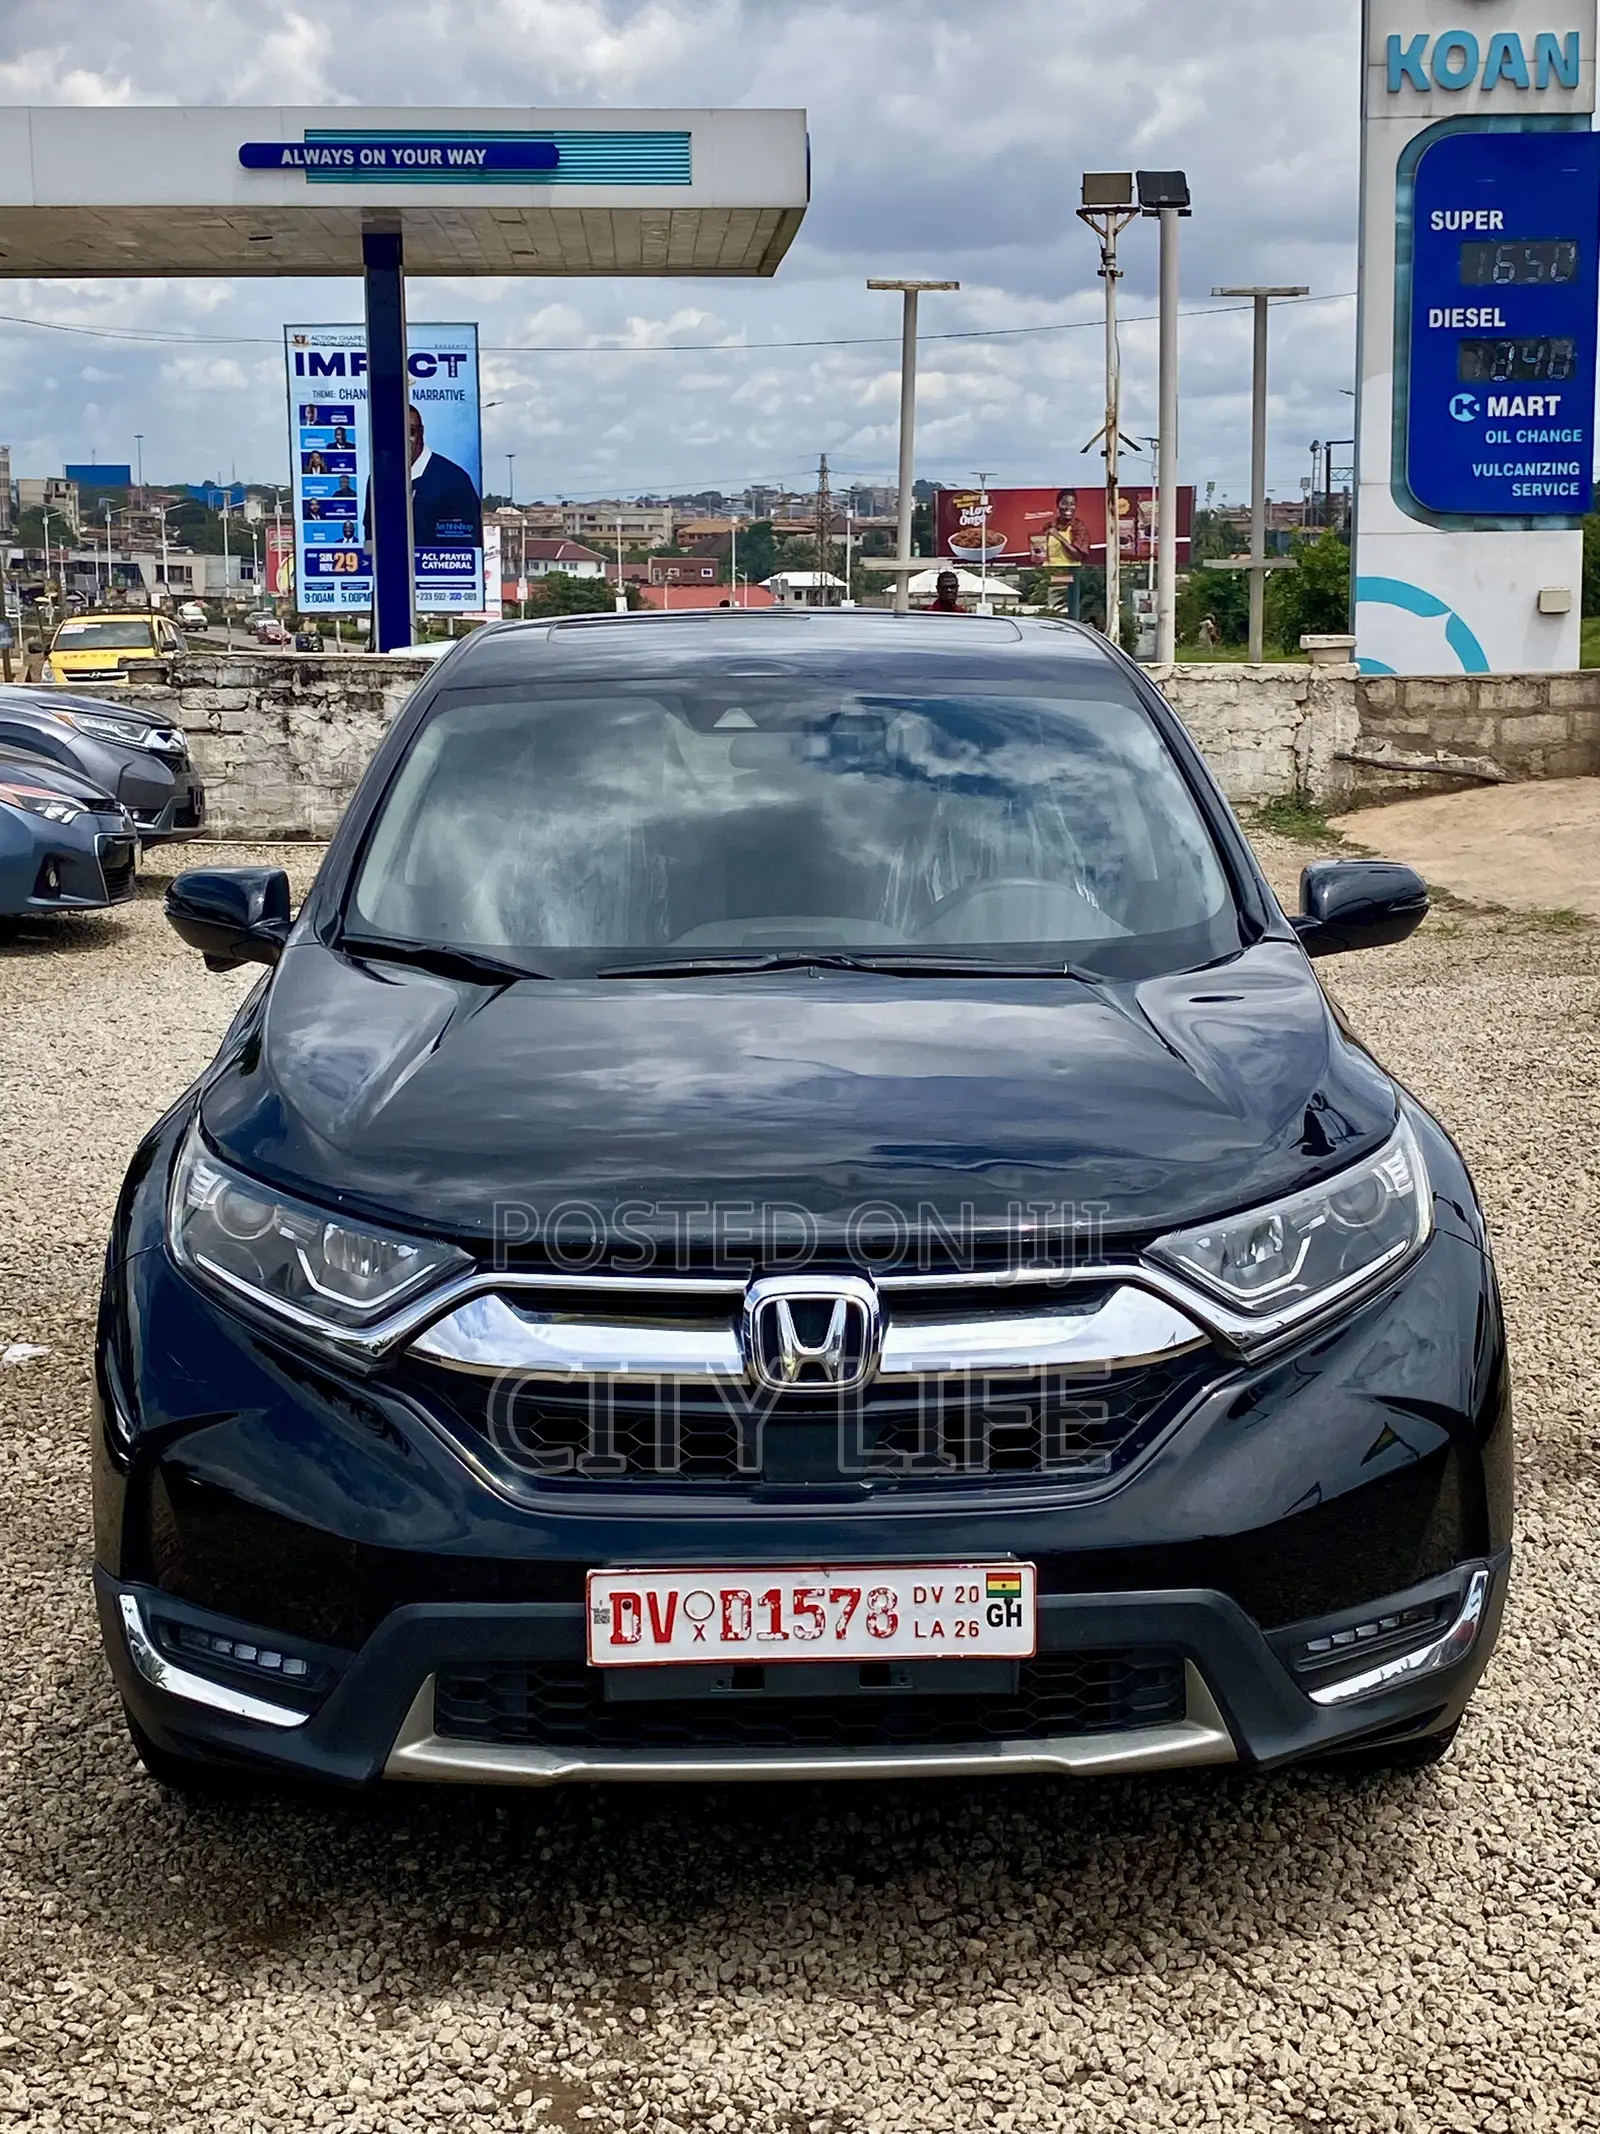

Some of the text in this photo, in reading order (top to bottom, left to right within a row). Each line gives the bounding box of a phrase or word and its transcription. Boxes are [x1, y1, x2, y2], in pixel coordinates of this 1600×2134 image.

[1387, 30, 1579, 93] KOAN
[281, 149, 487, 164] ALWAYS ON YOUR WAY
[1431, 210, 1504, 230] SUPER
[1428, 308, 1507, 328] DIESEL
[412, 389, 466, 401] NARRATIVE
[1487, 396, 1561, 417] MART
[1485, 429, 1582, 443] OIL CHANGE
[1472, 462, 1580, 477] VULCANIZING
[1512, 483, 1580, 496] SERVICE
[334, 552, 358, 572] 29
[440, 553, 472, 561] PRAYER
[913, 1586, 979, 1604] DV 20
[609, 1587, 899, 1645] DV D1578
[986, 1603, 1023, 1628] GH
[914, 1620, 979, 1638] LA 26
